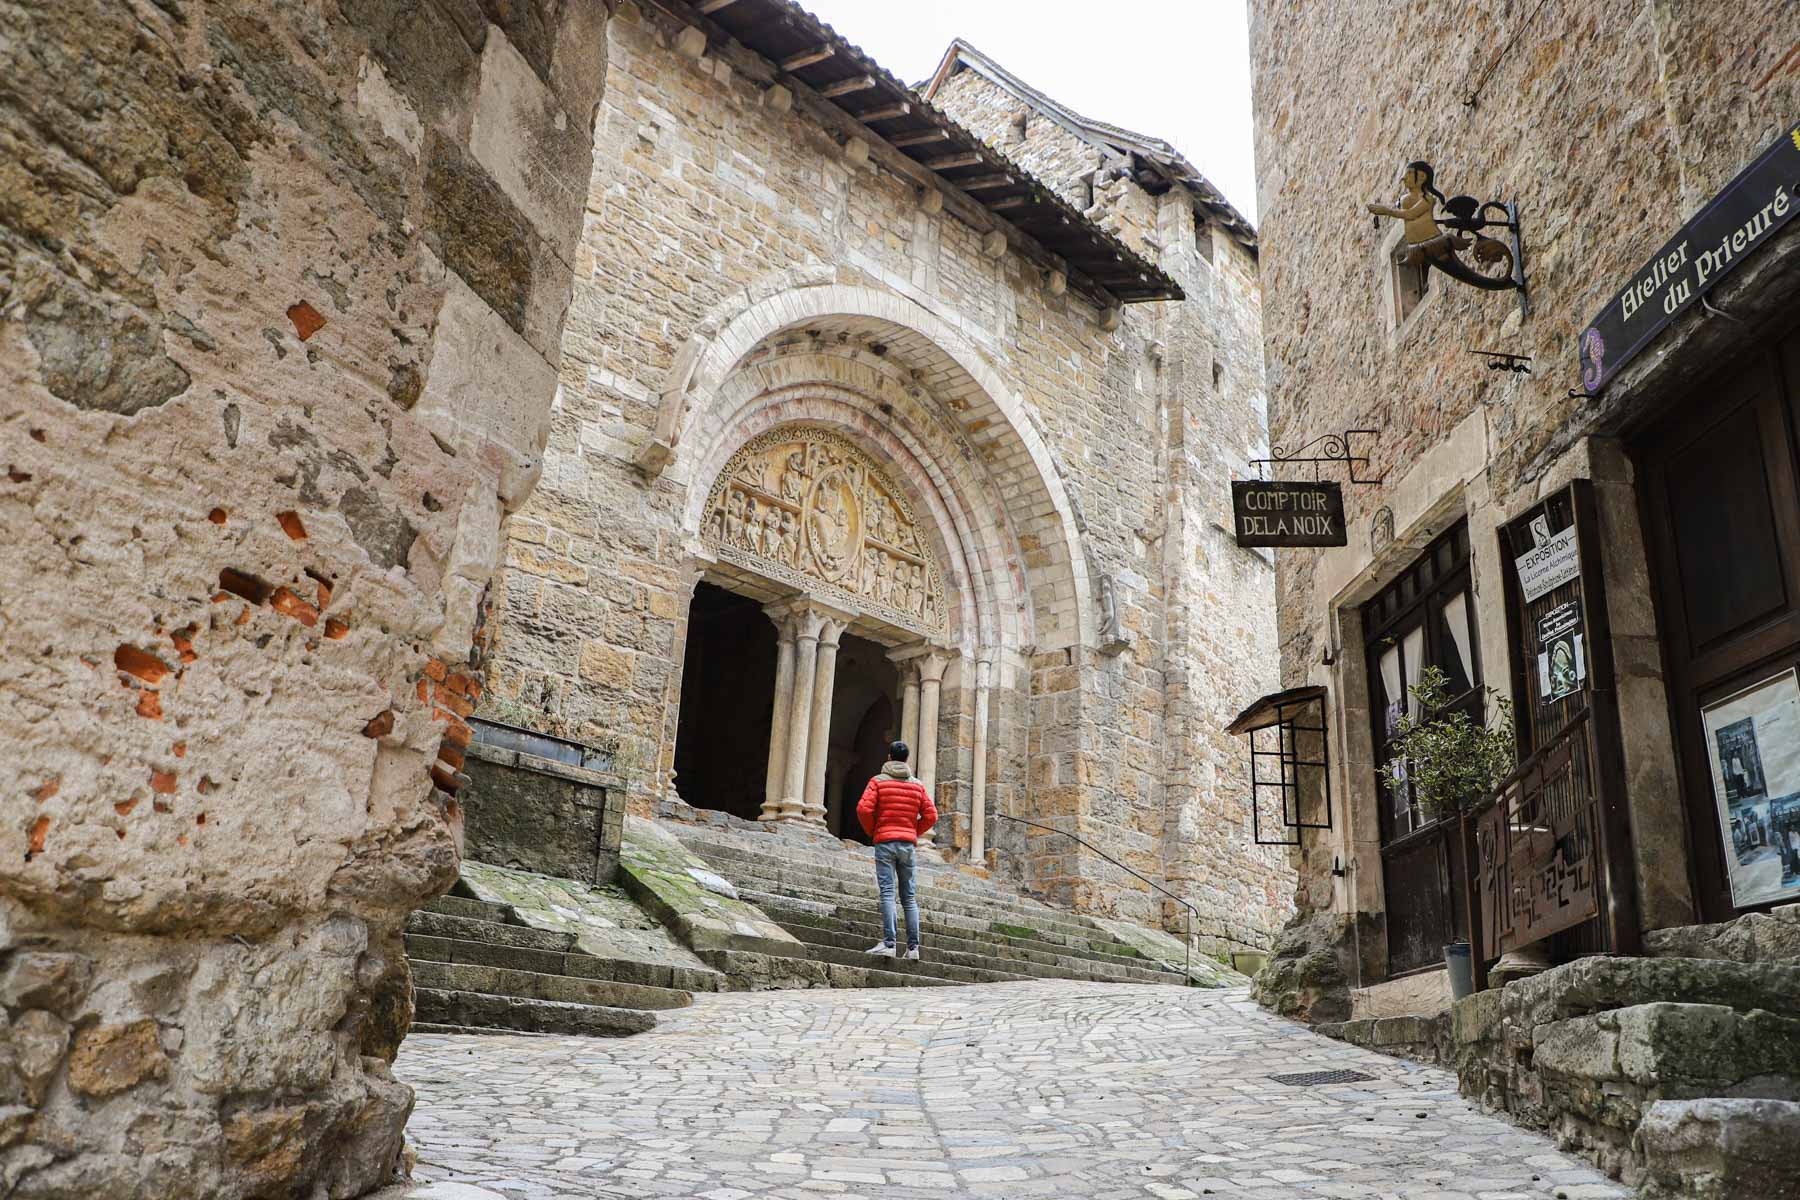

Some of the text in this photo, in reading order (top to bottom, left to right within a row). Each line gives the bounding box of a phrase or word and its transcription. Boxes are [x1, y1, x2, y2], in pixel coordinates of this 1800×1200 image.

[1663, 185, 1790, 315] du Prieuré
[1621, 239, 1688, 322] Atelier
[1245, 490, 1327, 511] COMPTOIR
[1293, 513, 1333, 535] NOIX
[1525, 536, 1569, 570] EXPOSITION
